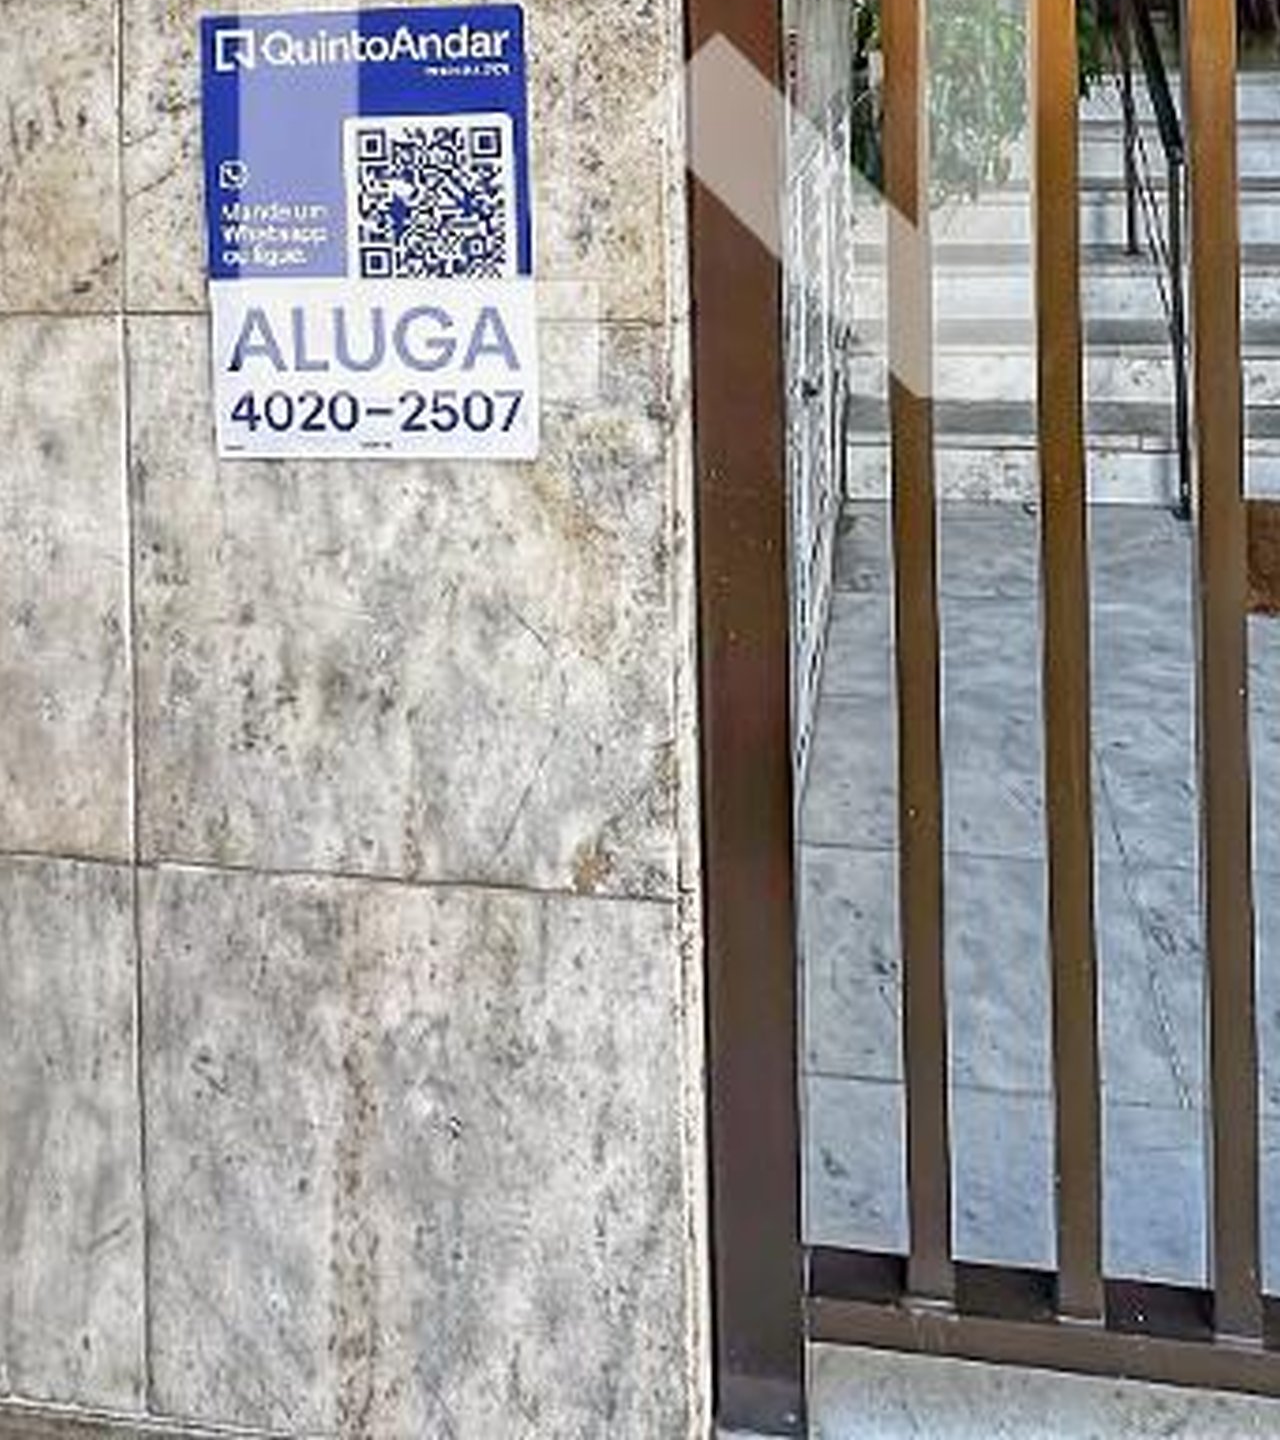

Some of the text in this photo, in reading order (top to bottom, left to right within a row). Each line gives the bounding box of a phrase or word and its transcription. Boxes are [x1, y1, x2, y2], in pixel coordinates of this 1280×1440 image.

[261, 23, 510, 66] QuintoAndar
[227, 306, 520, 371] ALUGA
[230, 391, 524, 432] 4020-2507
